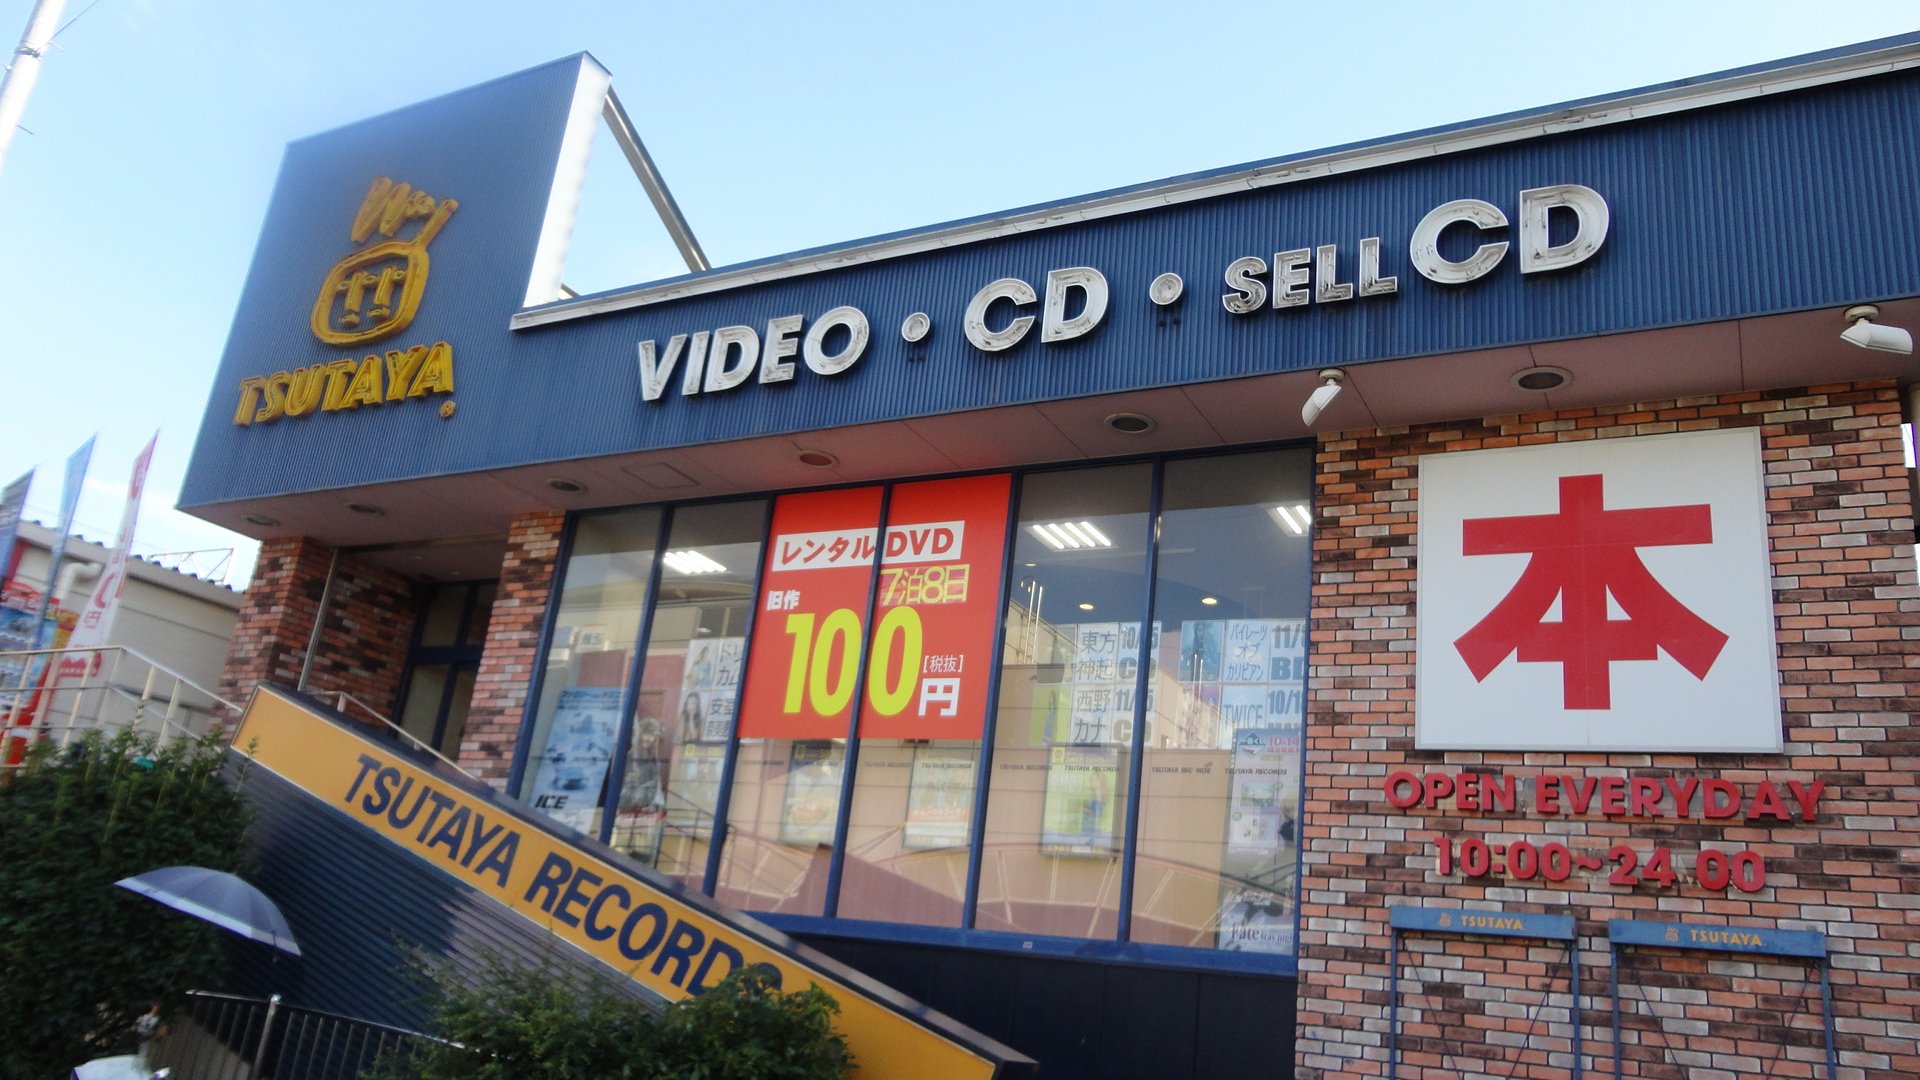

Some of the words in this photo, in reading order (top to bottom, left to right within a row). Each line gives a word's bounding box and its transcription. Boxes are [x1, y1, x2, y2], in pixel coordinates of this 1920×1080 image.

[638, 305, 870, 401] VIDEO
[963, 266, 1109, 353] CD
[1223, 236, 1398, 315] SELL
[1409, 183, 1610, 285] CD
[233, 341, 454, 427] TSUTAYA
[781, 535, 876, 565] レンタル
[885, 527, 954, 557] DVD
[879, 563, 971, 606] 7泊8日
[1453, 474, 1730, 710] 本
[765, 589, 801, 611] 旧作
[1081, 630, 1117, 654] 東方
[1272, 624, 1305, 648] 11/
[783, 605, 923, 717] 100
[1236, 643, 1261, 659] オブ
[1077, 657, 1113, 680] 神起
[917, 677, 961, 716] 円
[1076, 689, 1111, 713] 西野
[1268, 689, 1301, 714] 10/1
[1074, 718, 1107, 742] カナ
[534, 795, 569, 809] ICE
[1384, 772, 1515, 812] OPEN
[1535, 775, 1825, 821] EVERYDAY
[344, 754, 522, 889] TSUTAYA
[1231, 922, 1259, 941] Fate
[1461, 916, 1524, 931] TSUTAYA
[1690, 930, 1763, 947] TSUTAYA
